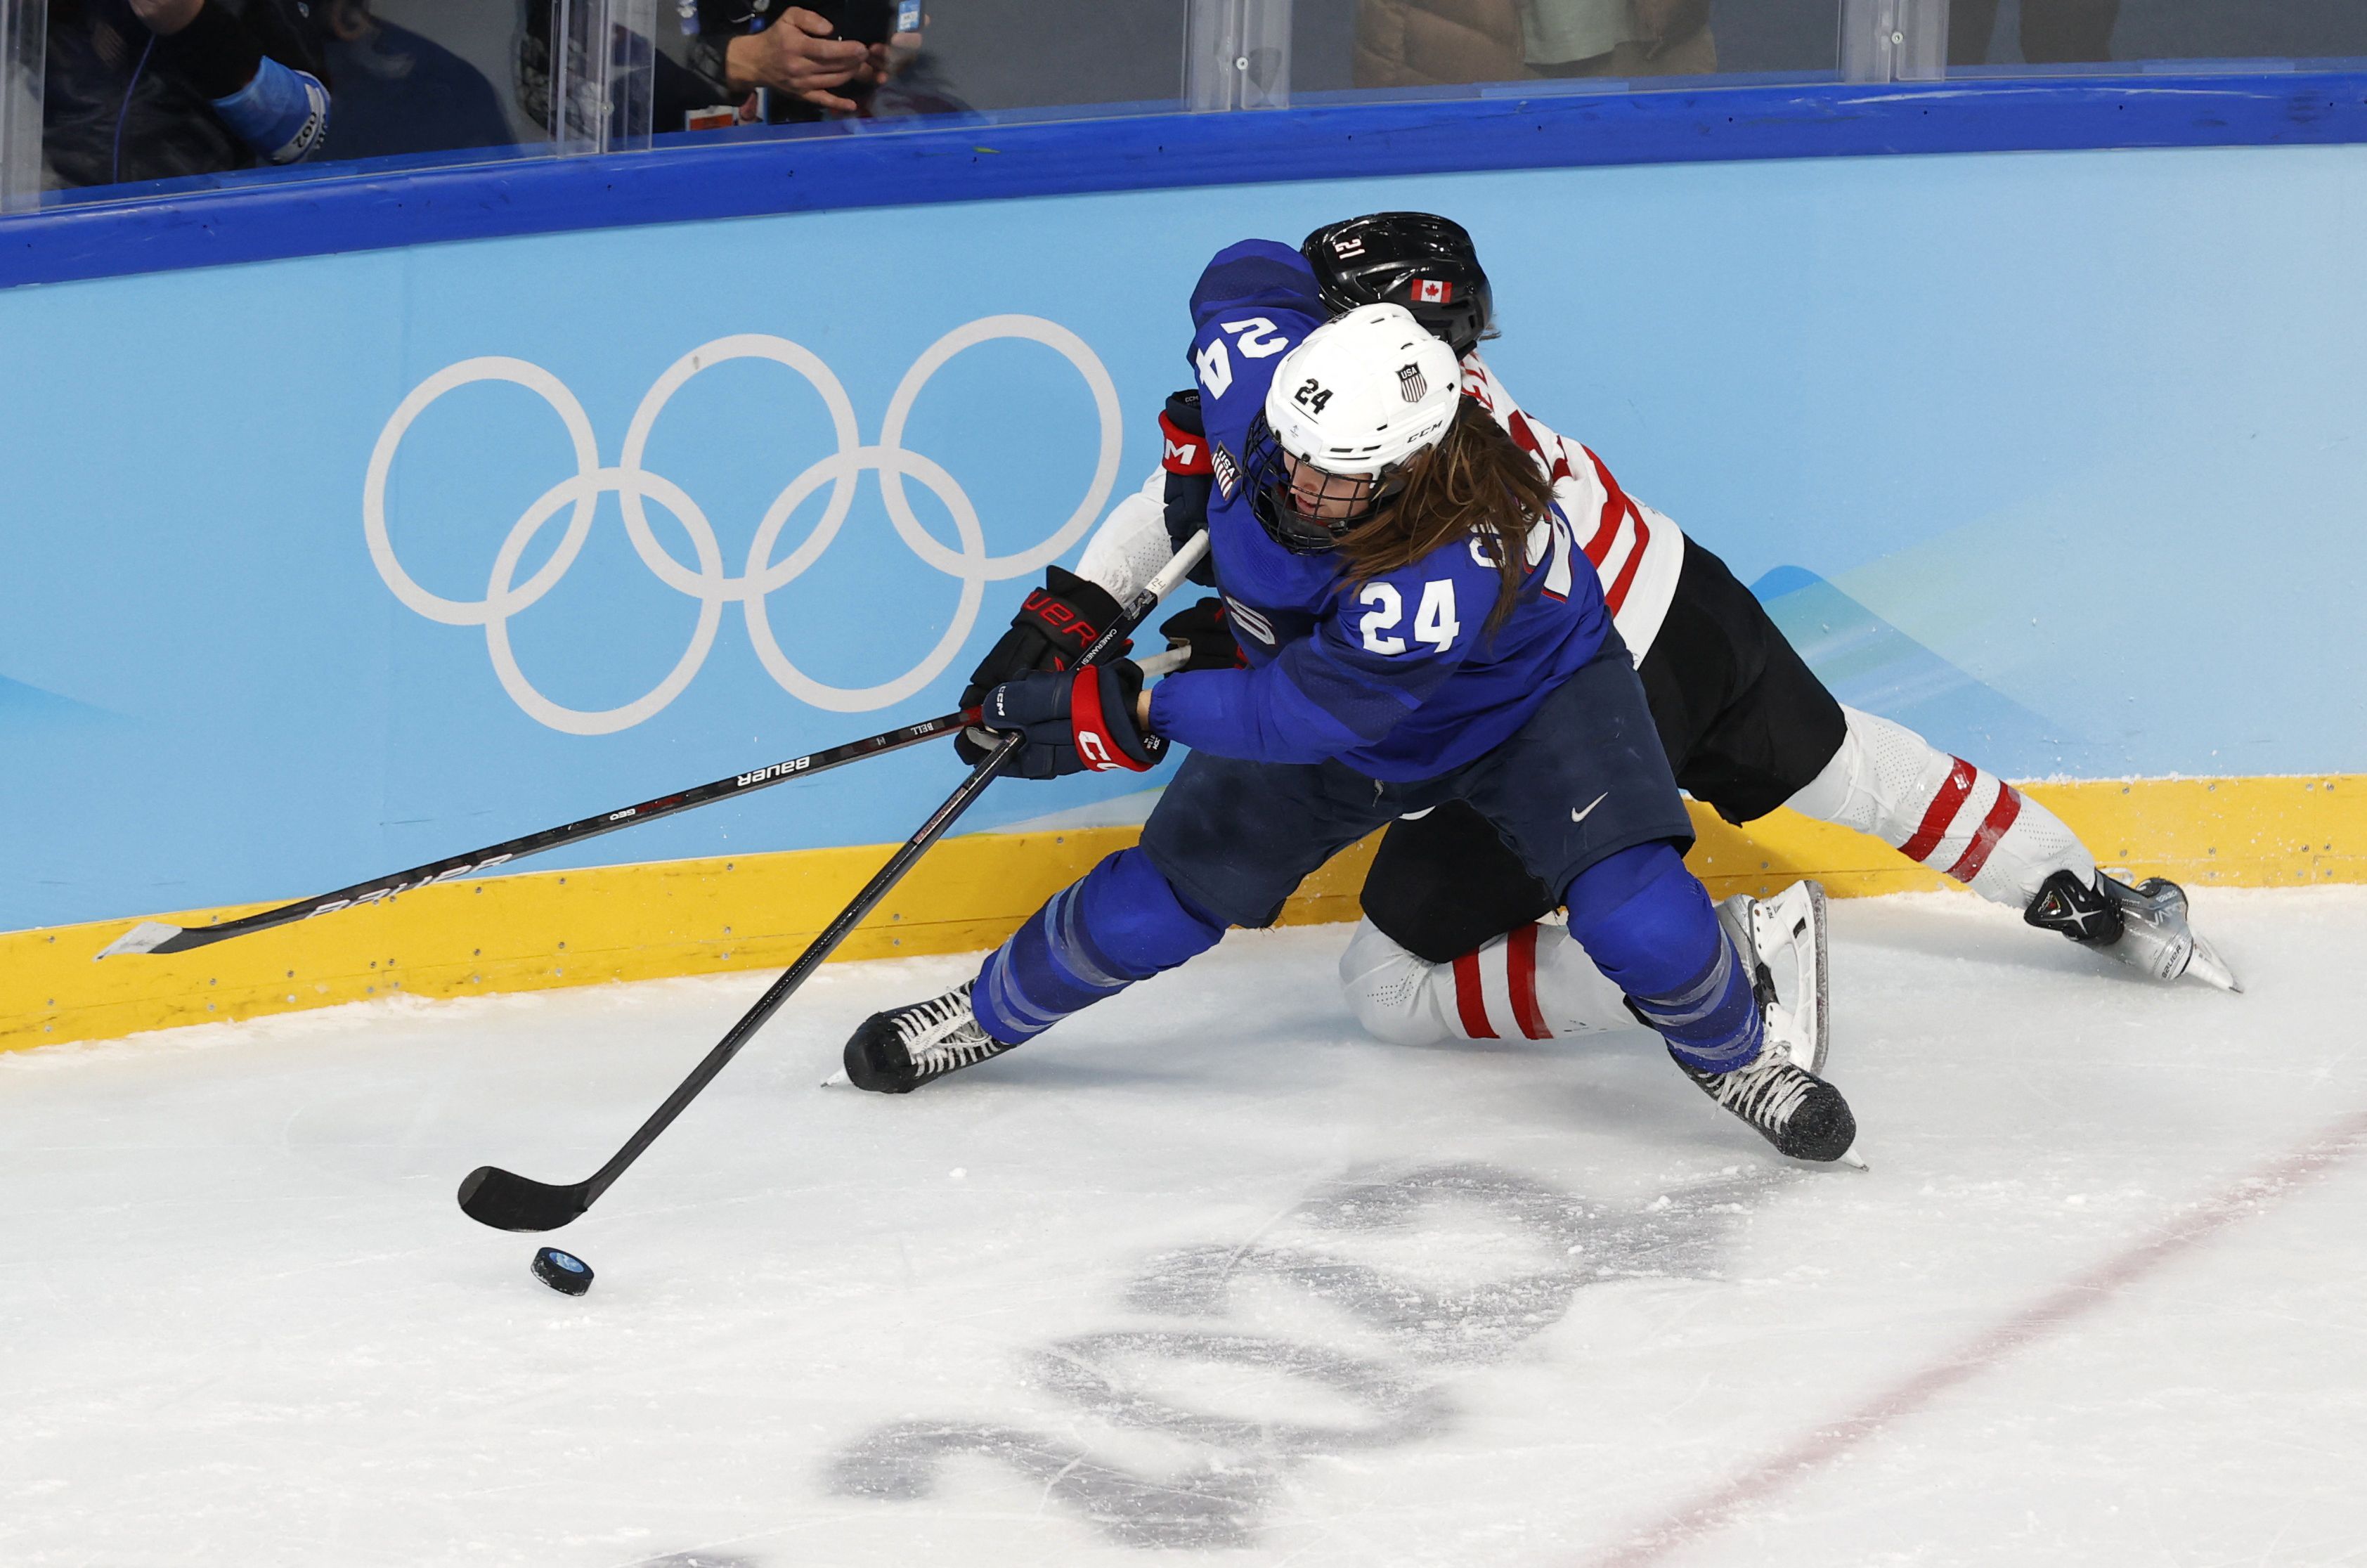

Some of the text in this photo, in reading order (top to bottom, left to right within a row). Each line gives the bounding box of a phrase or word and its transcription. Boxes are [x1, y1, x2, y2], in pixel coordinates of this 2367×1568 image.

[1335, 238, 1365, 259] 21
[1195, 317, 1290, 401] 24
[1401, 366, 1417, 380] USA
[1294, 378, 1334, 415] 24
[1407, 420, 1443, 443] CCM
[1219, 450, 1236, 477] USA
[1023, 592, 1099, 648] UER
[1359, 578, 1460, 654] 24
[1081, 628, 1117, 665] CAMERANESI
[997, 685, 1006, 716] CCM
[910, 722, 934, 735] BELL
[737, 756, 810, 786] BAUER
[2161, 945, 2182, 978] BAUER
